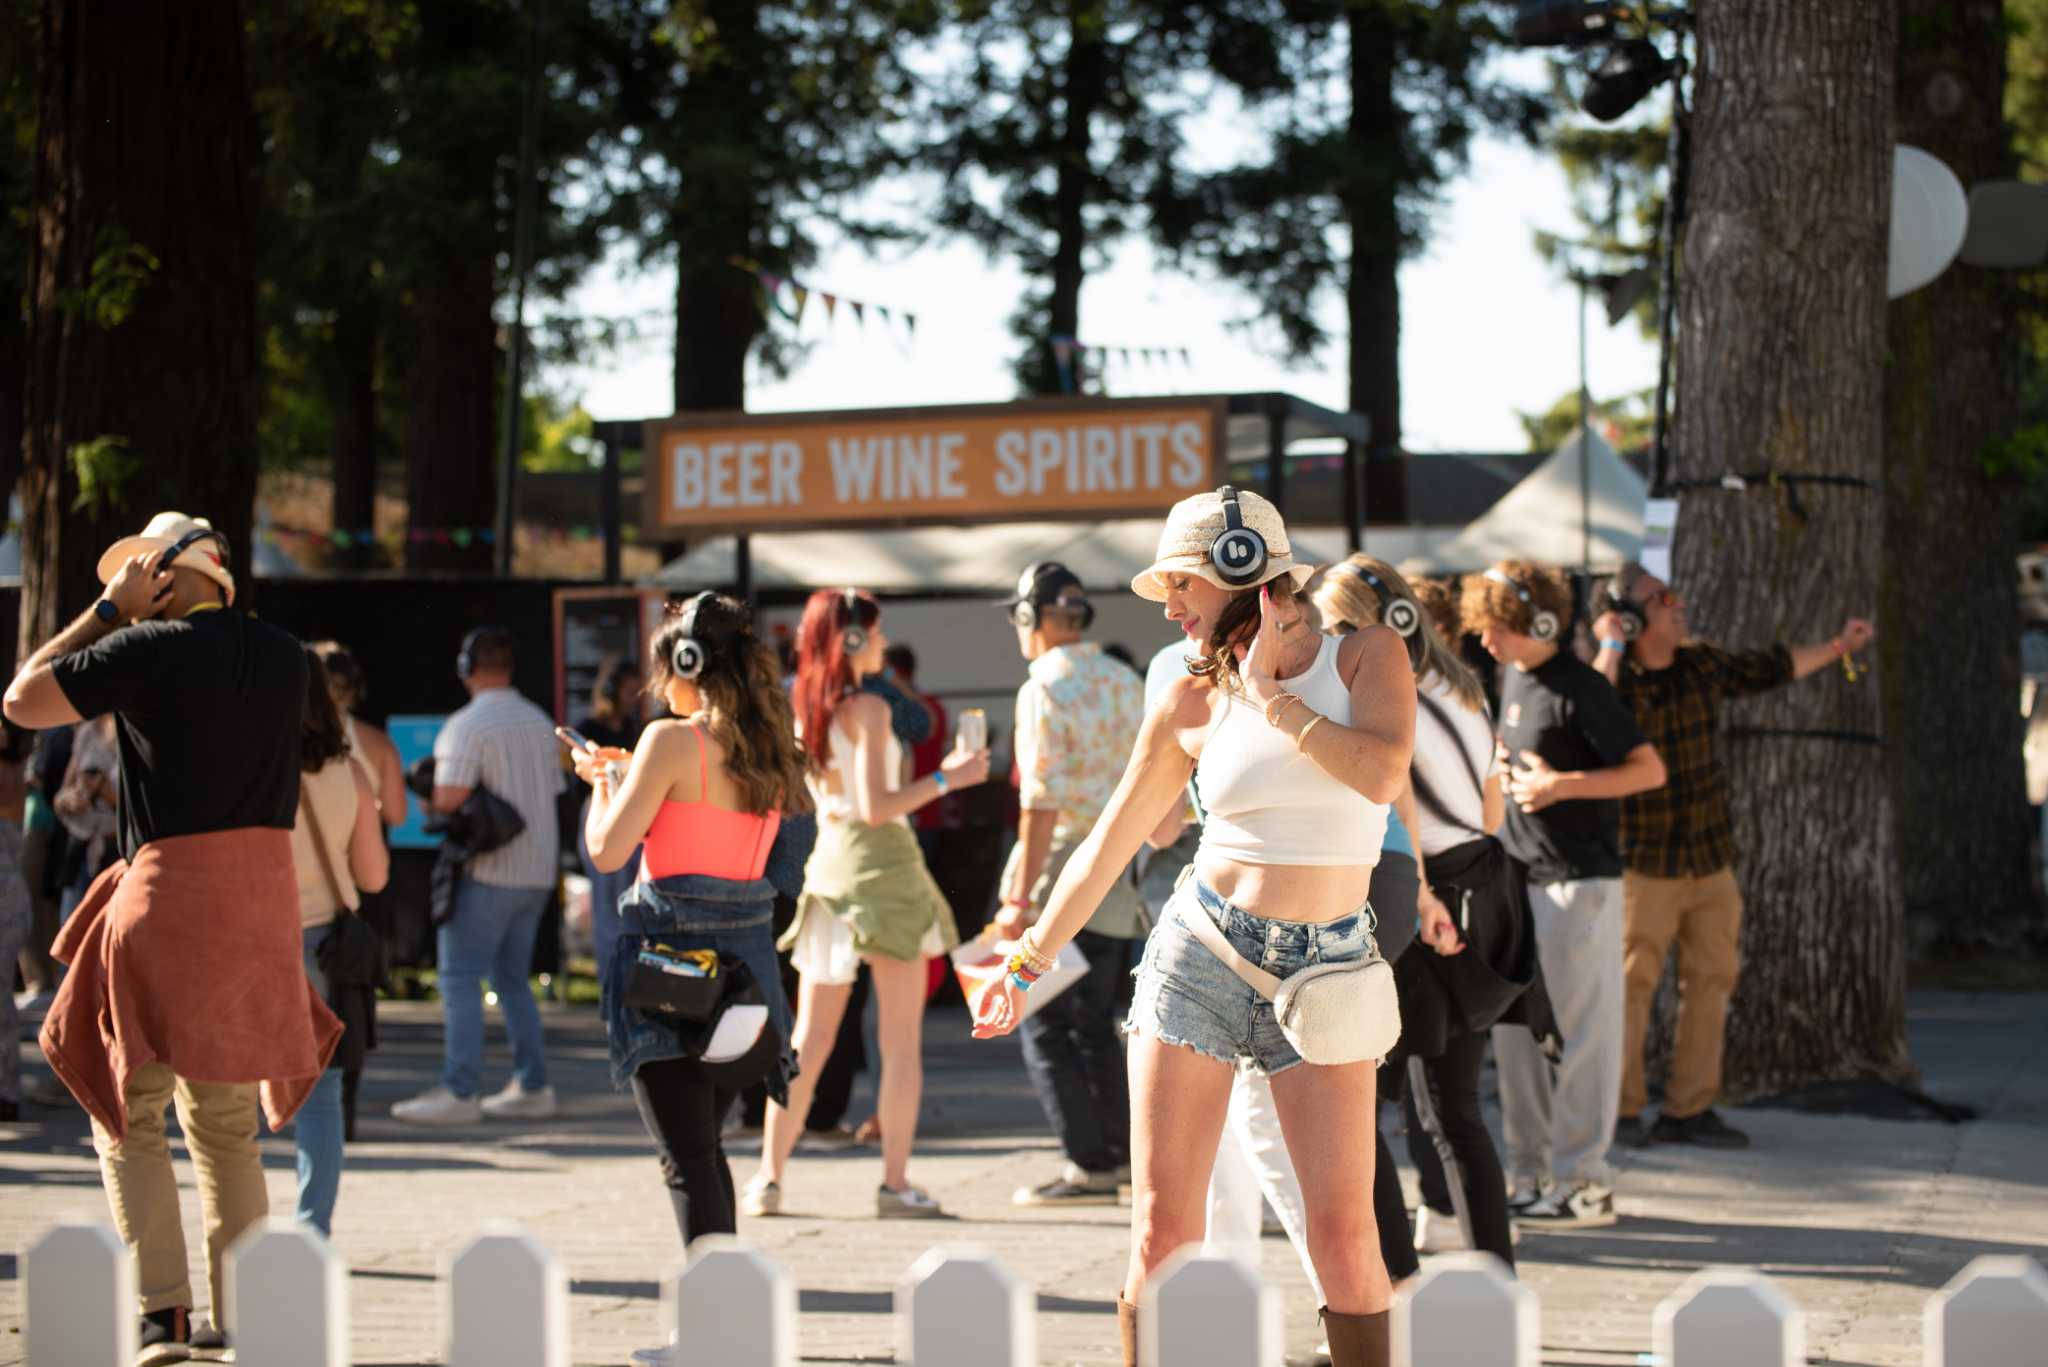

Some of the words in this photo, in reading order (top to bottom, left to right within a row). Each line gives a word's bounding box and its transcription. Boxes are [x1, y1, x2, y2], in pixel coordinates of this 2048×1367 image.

[672, 438, 804, 510] BEER
[827, 433, 967, 503] WINE
[994, 421, 1204, 497] SPIRITS
